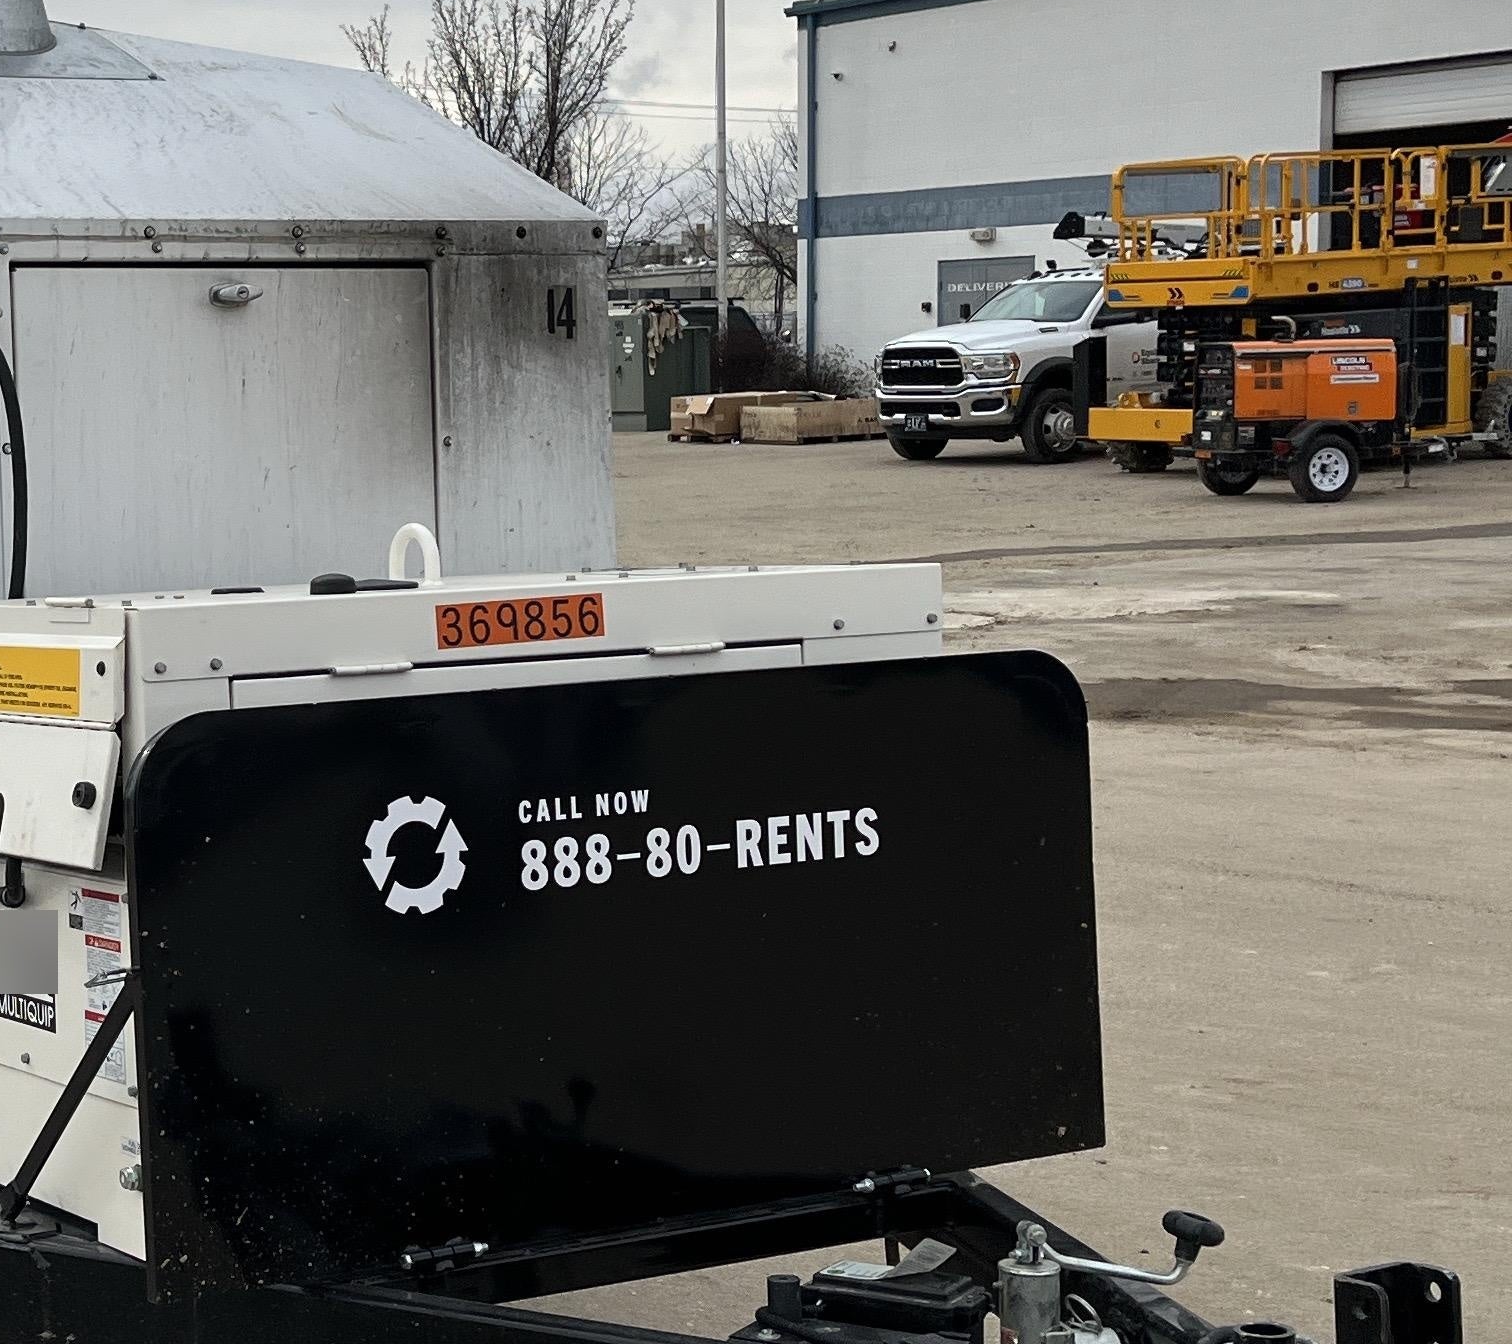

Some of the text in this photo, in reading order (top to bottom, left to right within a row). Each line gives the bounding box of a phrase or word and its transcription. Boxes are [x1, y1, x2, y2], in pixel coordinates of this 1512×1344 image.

[547, 287, 577, 340] 14
[900, 359, 935, 368] RAM
[441, 596, 599, 647] 369856
[518, 789, 650, 824] CALL NOW
[520, 807, 880, 891] 888-80-RENTS
